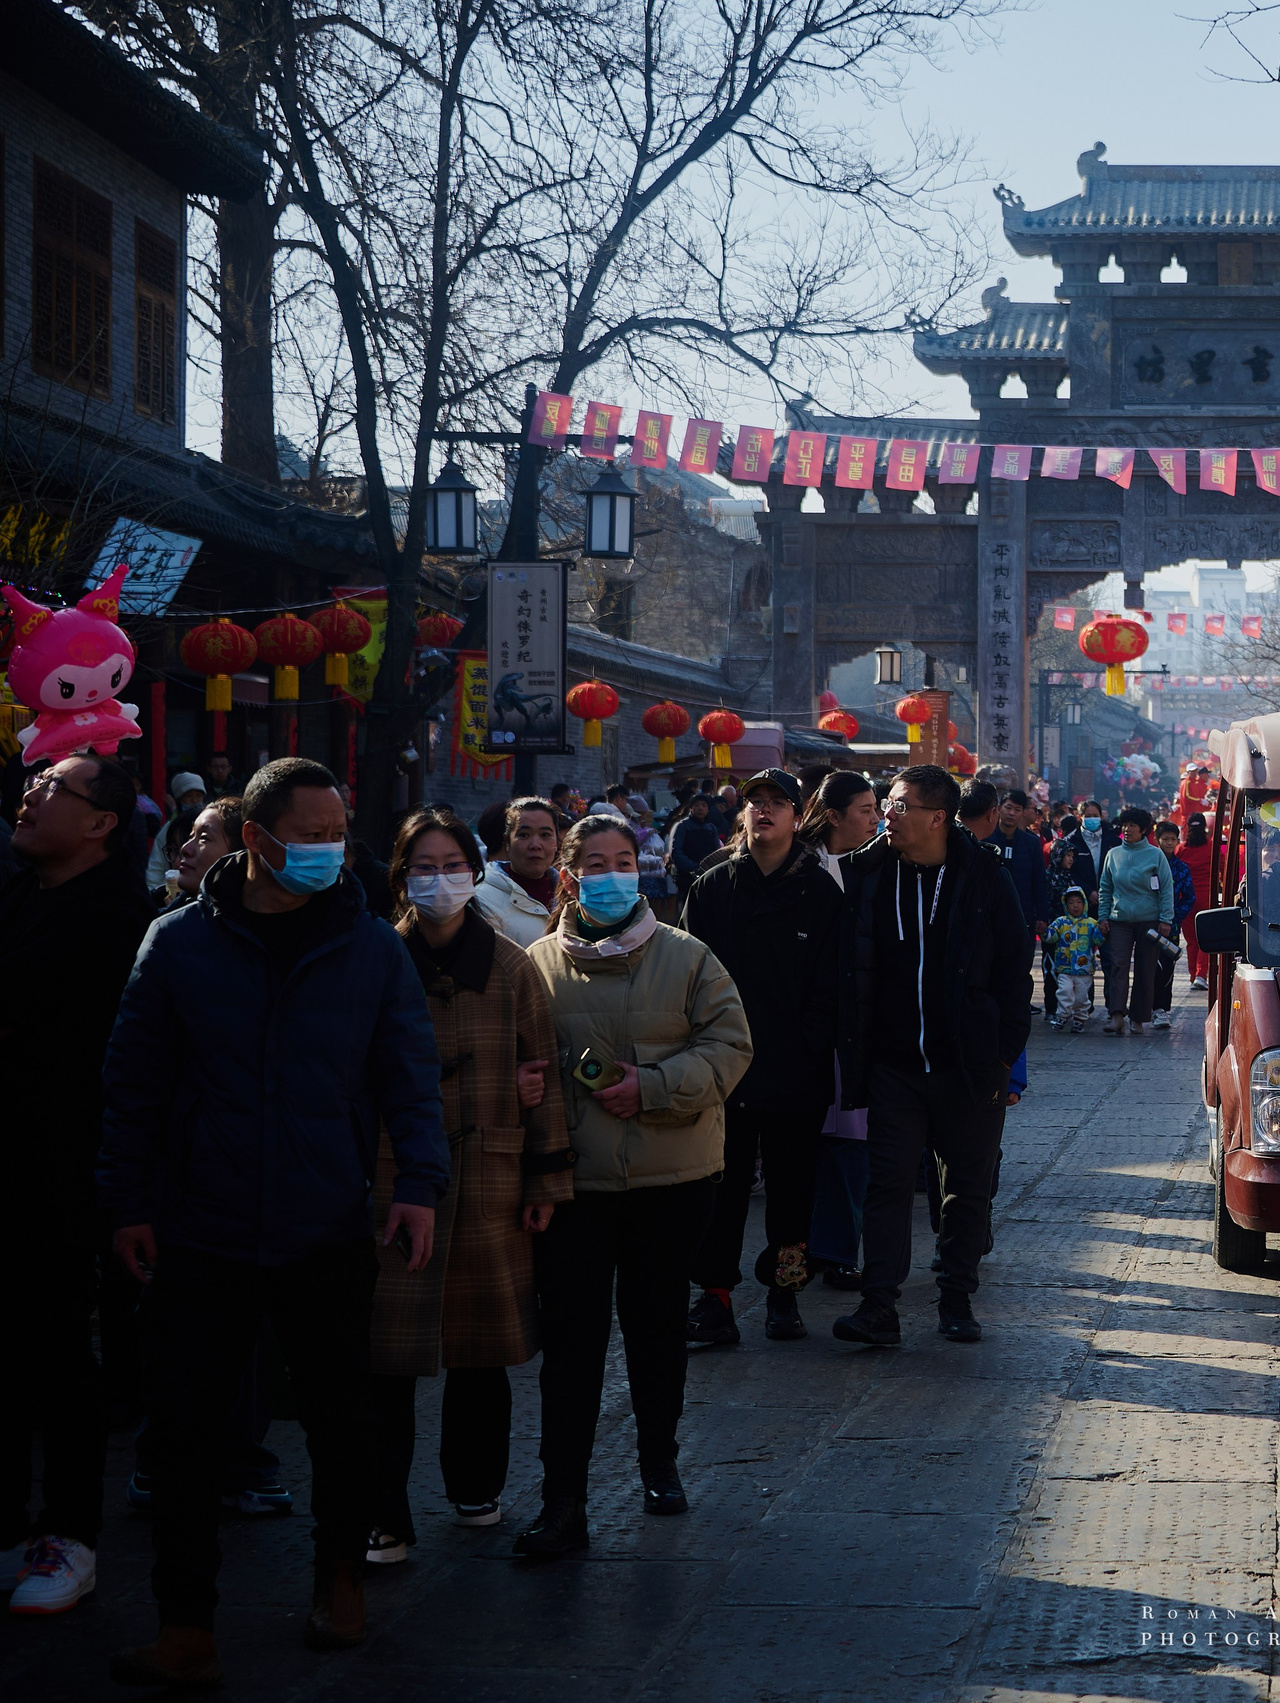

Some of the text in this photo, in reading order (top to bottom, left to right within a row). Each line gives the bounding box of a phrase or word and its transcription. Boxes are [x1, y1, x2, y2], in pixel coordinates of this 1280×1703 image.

[516, 589, 533, 663] 奇幻侏罗纪
[501, 640, 510, 668] 欢迎您
